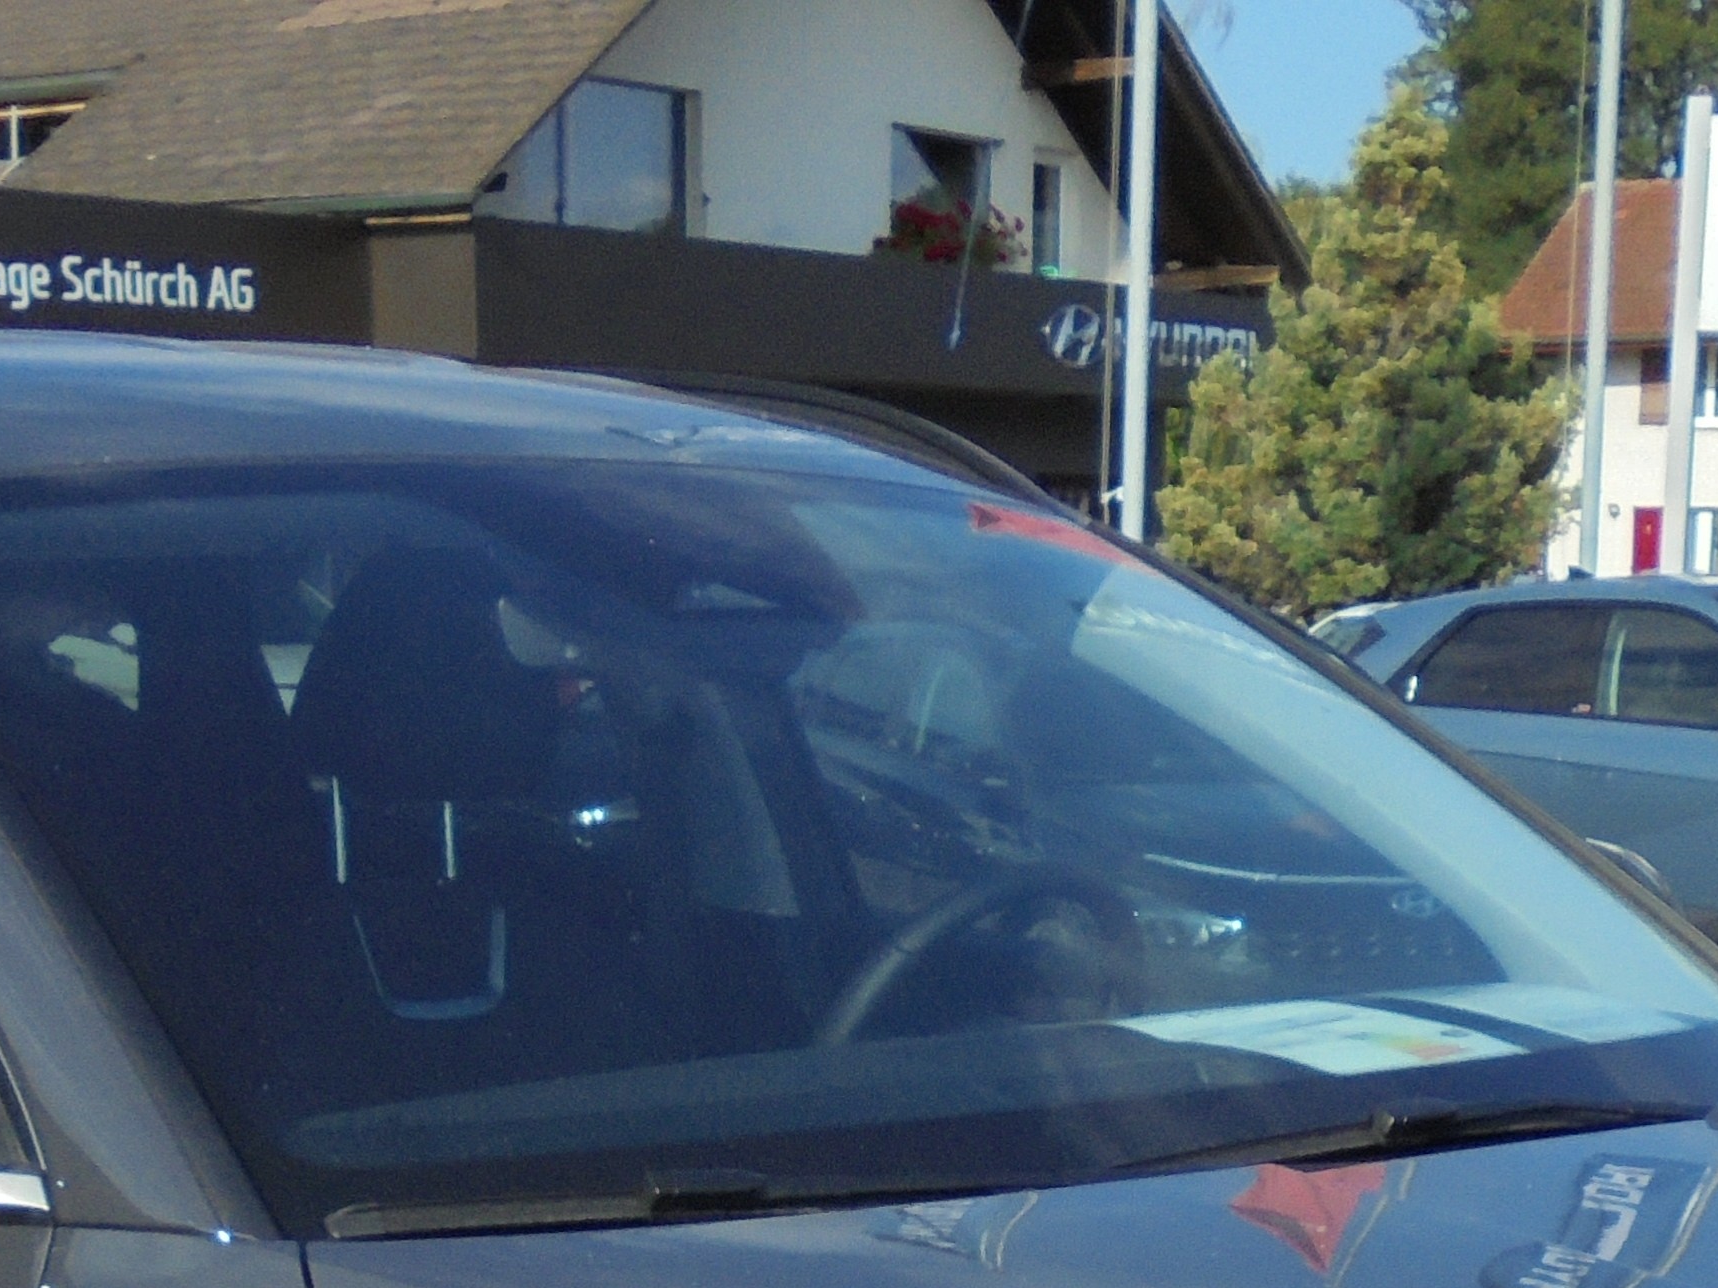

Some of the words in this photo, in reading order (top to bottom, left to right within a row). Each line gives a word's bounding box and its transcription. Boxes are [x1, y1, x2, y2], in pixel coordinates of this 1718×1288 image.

[59, 254, 199, 308] Schürch
[205, 265, 255, 313] AG
[1100, 317, 1258, 368] UNDAI
